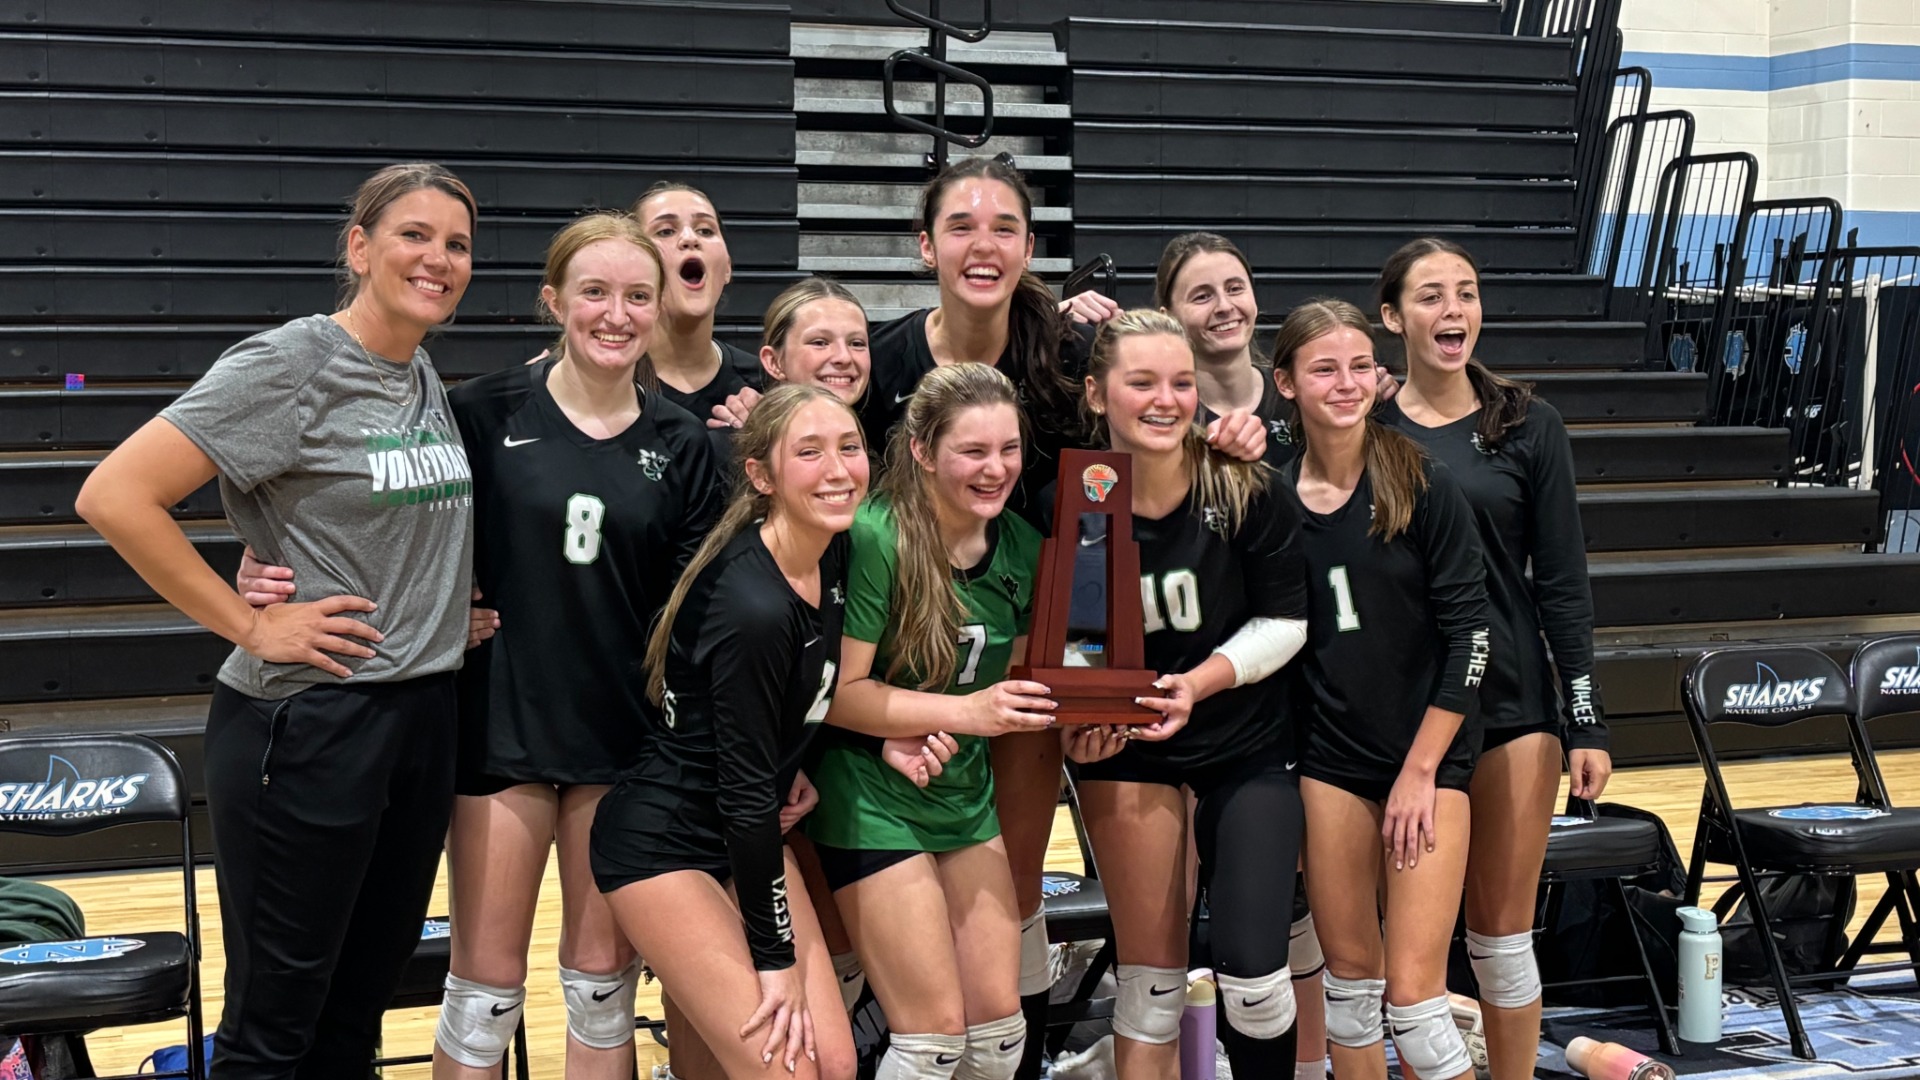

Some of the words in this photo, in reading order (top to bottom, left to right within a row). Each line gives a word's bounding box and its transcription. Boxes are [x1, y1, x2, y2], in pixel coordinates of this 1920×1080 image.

[563, 492, 606, 565] 8
[1140, 568, 1203, 635] 10
[1327, 564, 1361, 632] 1
[956, 623, 988, 686] 7
[803, 659, 837, 726] 2
[1723, 677, 1827, 708] SHARKS
[1771, 703, 1815, 714] COAST
[1880, 688, 1920, 696] NATUR
[0, 773, 150, 814] SHARKS
[61, 806, 126, 819] COAST
[1704, 953, 1720, 979] P
